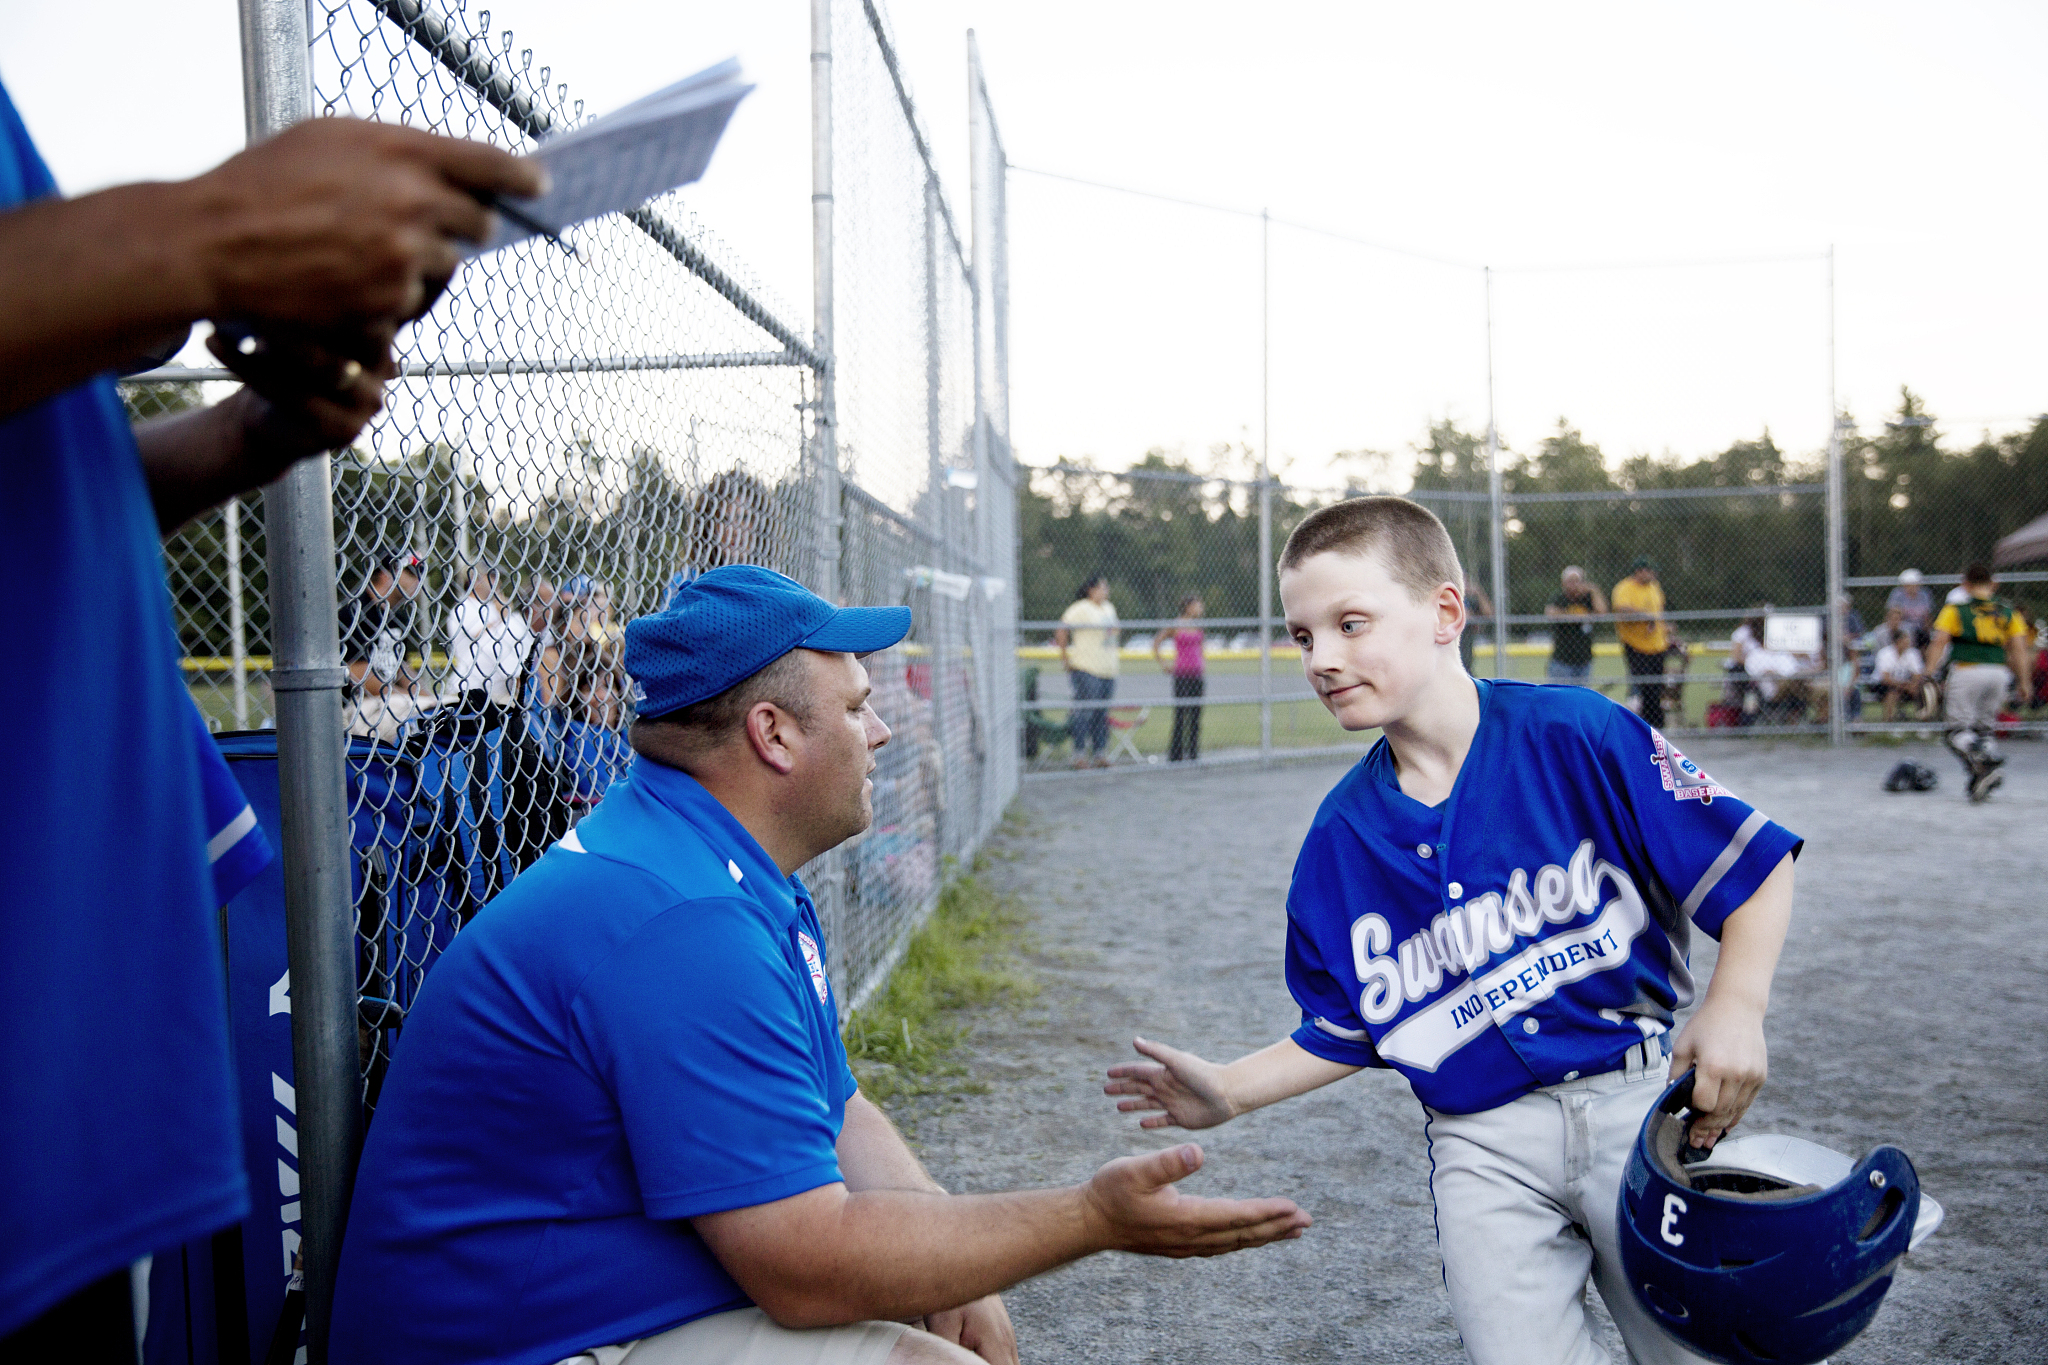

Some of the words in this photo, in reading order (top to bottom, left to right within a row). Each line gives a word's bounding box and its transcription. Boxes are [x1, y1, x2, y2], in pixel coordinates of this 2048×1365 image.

[1652, 729, 1673, 790] SWANSE
[1676, 786, 1733, 800] BASEBA
[1351, 838, 1609, 1024] Swansea
[1450, 928, 1619, 1029] INDEPENDENT
[1661, 1194, 1687, 1246] 3
